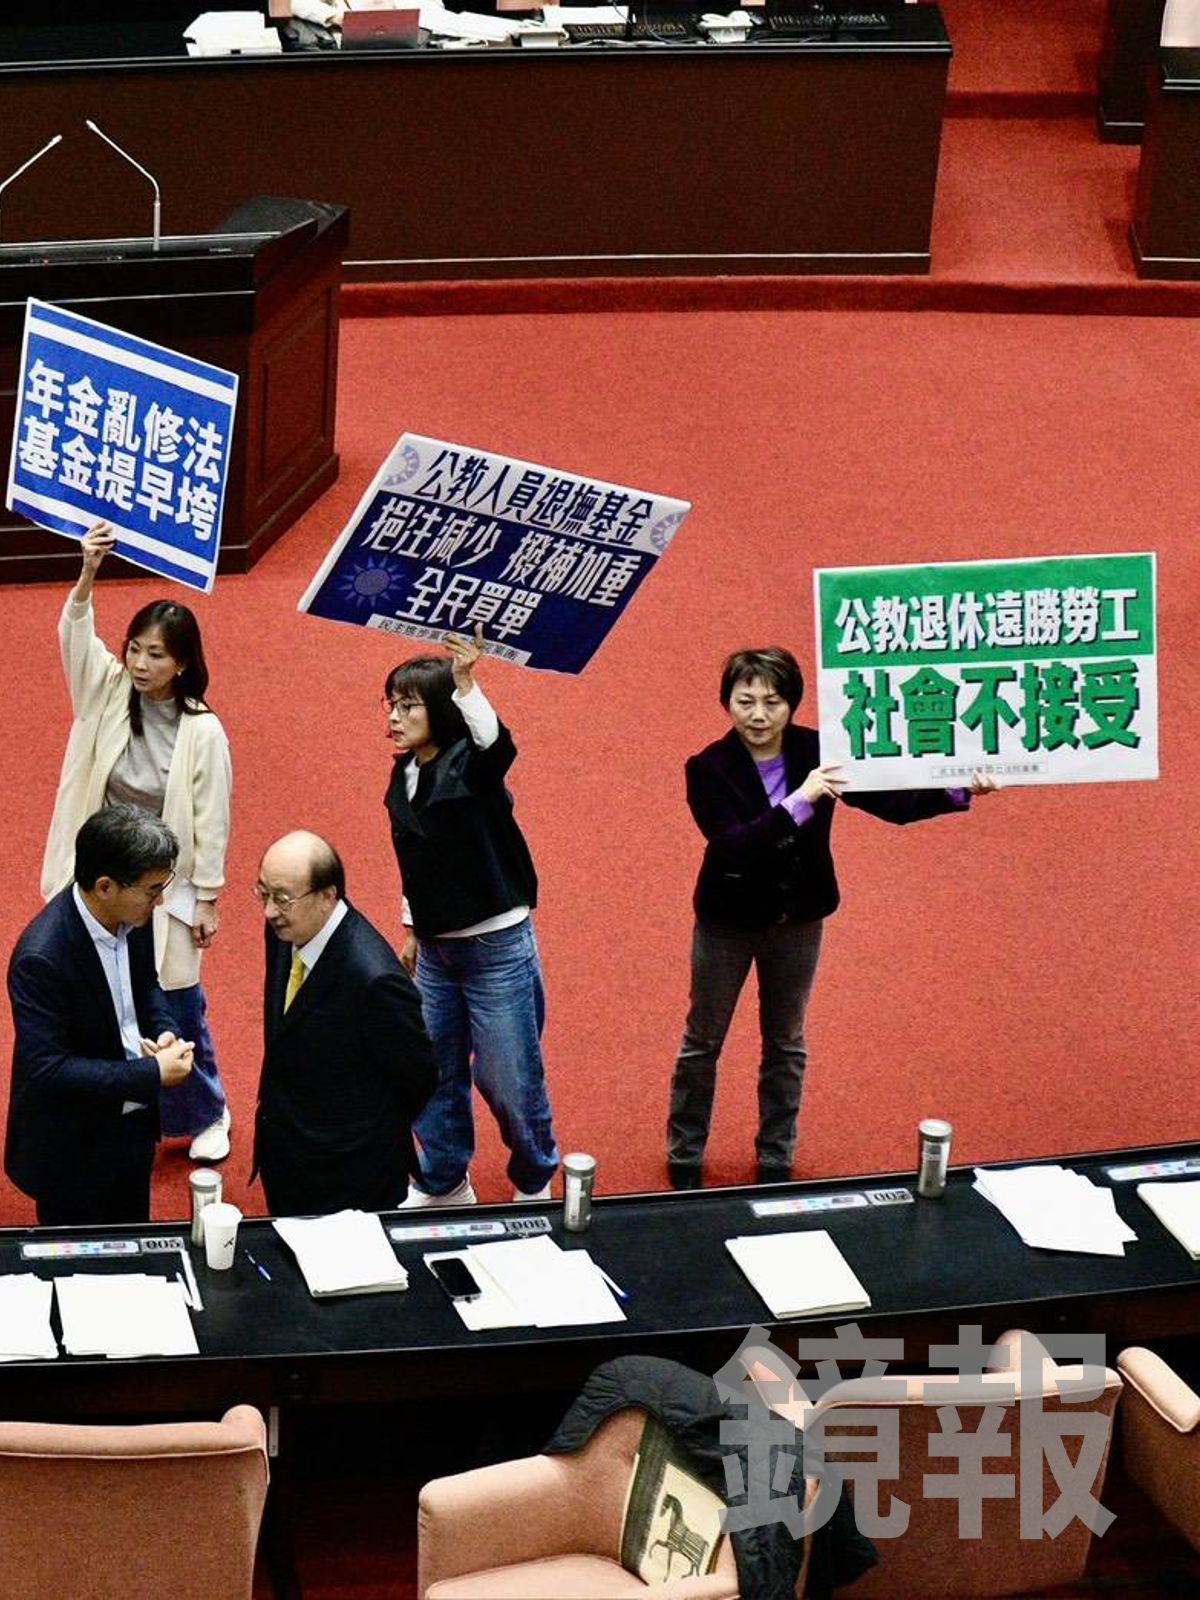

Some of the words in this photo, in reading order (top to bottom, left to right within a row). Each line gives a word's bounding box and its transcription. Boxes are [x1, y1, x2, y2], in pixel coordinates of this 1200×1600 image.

[26, 358, 223, 484] 年金亂修法
[19, 415, 217, 541] 基金提早垮
[414, 449, 654, 546] 公教人員退撫基金
[361, 498, 503, 569] 挹注減少
[498, 531, 642, 608] 撥補加重
[395, 566, 543, 641] 全民買單
[835, 587, 1140, 655] 公教退休遠勝勞工
[841, 659, 1141, 760] 社會不接受
[145, 1239, 181, 1250] 005
